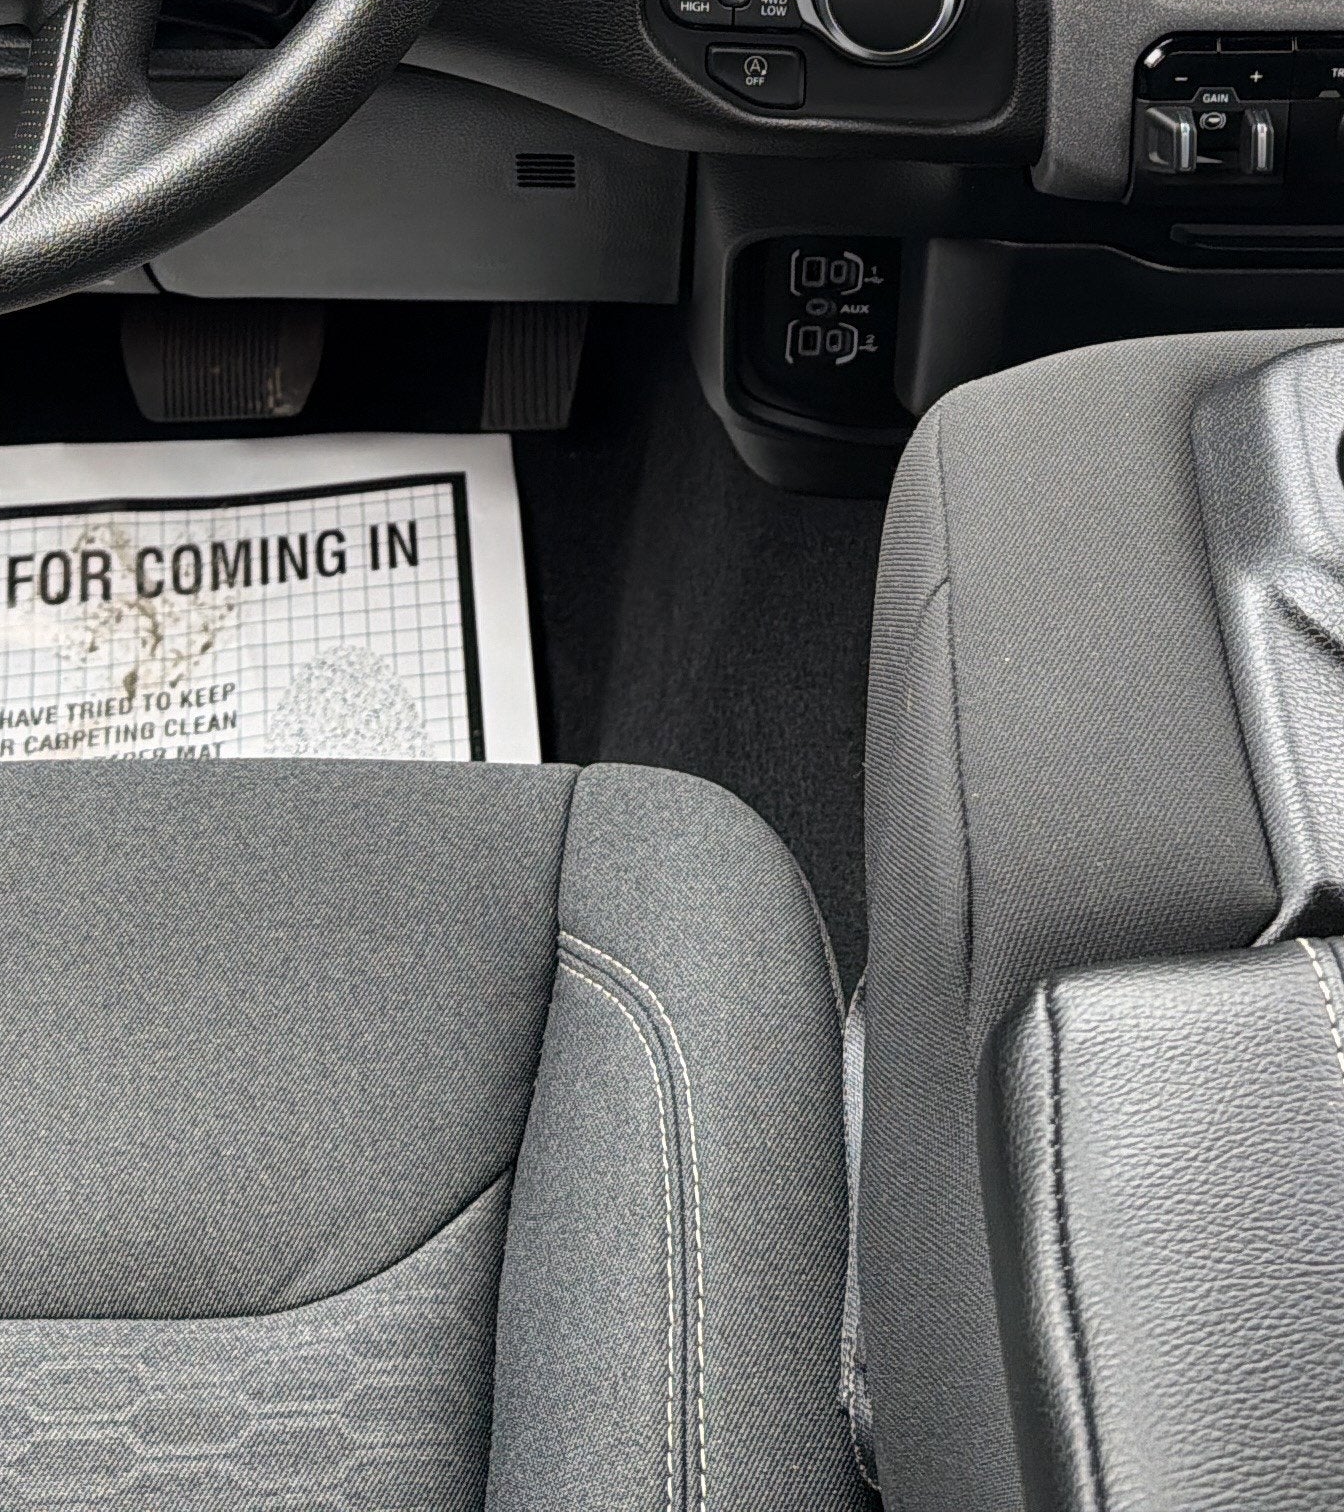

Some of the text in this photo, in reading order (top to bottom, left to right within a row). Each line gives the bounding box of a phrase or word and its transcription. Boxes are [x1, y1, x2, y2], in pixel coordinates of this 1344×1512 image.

[680, 1, 710, 13] HIGH
[760, 5, 788, 17] LOW
[744, 75, 765, 87] OFF
[1202, 92, 1229, 104] GAIN
[840, 303, 871, 315] AUX
[6, 543, 115, 610] FOR
[135, 528, 349, 601] COMING
[368, 520, 421, 574] IN
[67, 696, 134, 723] TRIED
[142, 691, 172, 712] TO
[179, 681, 236, 709] KEEP
[24, 721, 155, 755] CARPETING
[164, 709, 238, 738] CLEAN
